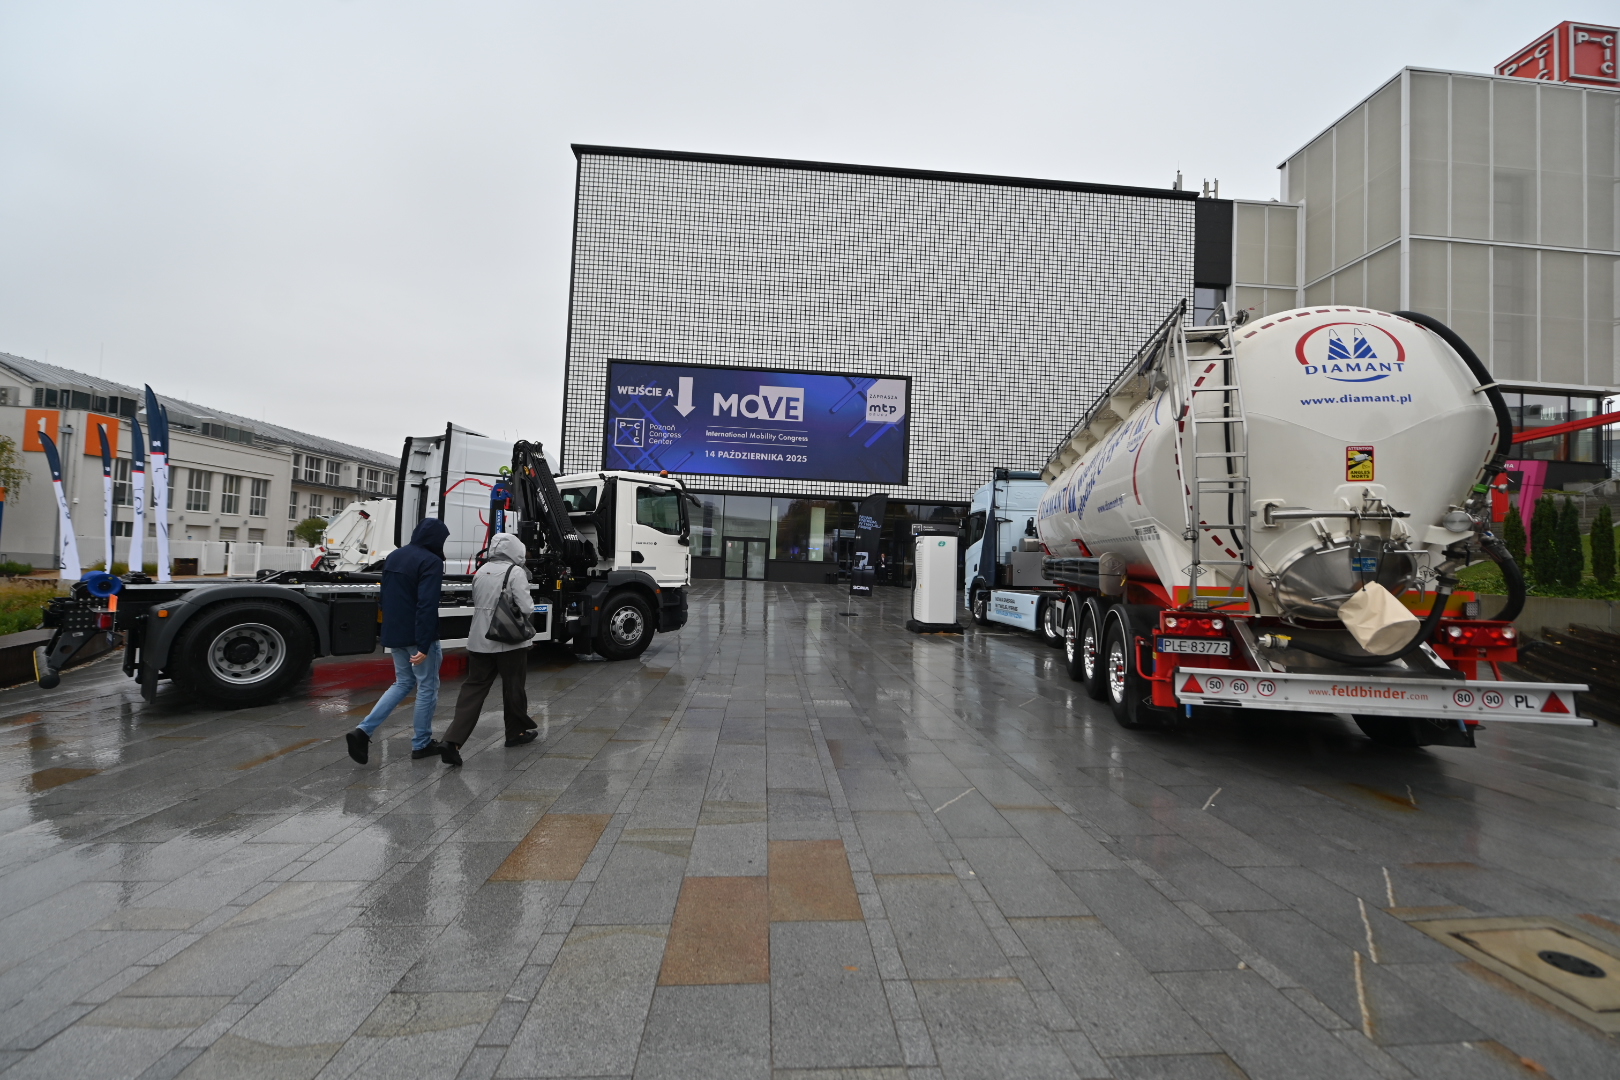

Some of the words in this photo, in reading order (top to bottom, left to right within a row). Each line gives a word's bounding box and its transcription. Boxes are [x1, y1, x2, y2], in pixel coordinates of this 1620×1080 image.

[1304, 362, 1405, 376] DIAMANT
[617, 384, 662, 398] WEJŚCIE
[664, 387, 674, 398] A
[712, 391, 801, 420] MOVE
[1300, 393, 1412, 406] www.diamant.pl
[869, 403, 897, 415] mtp
[649, 423, 676, 431] Poznań
[648, 430, 682, 439] Congress
[705, 430, 748, 440] International
[749, 431, 777, 443] Mobility
[778, 432, 809, 443] Congress
[648, 437, 673, 445] Center
[704, 449, 716, 459] 14
[718, 448, 784, 462] PAŹDZIERNIKA
[785, 453, 808, 464] 2025
[1164, 640, 1187, 652] PLE
[1190, 641, 1229, 654] 83773
[1209, 680, 1222, 690] 50
[1233, 682, 1246, 692] 60
[1260, 683, 1273, 693] 70
[1308, 685, 1428, 700] www.feldbinder.com
[1457, 693, 1471, 703] 80
[1485, 694, 1500, 705] 90
[1514, 694, 1535, 709] PL
